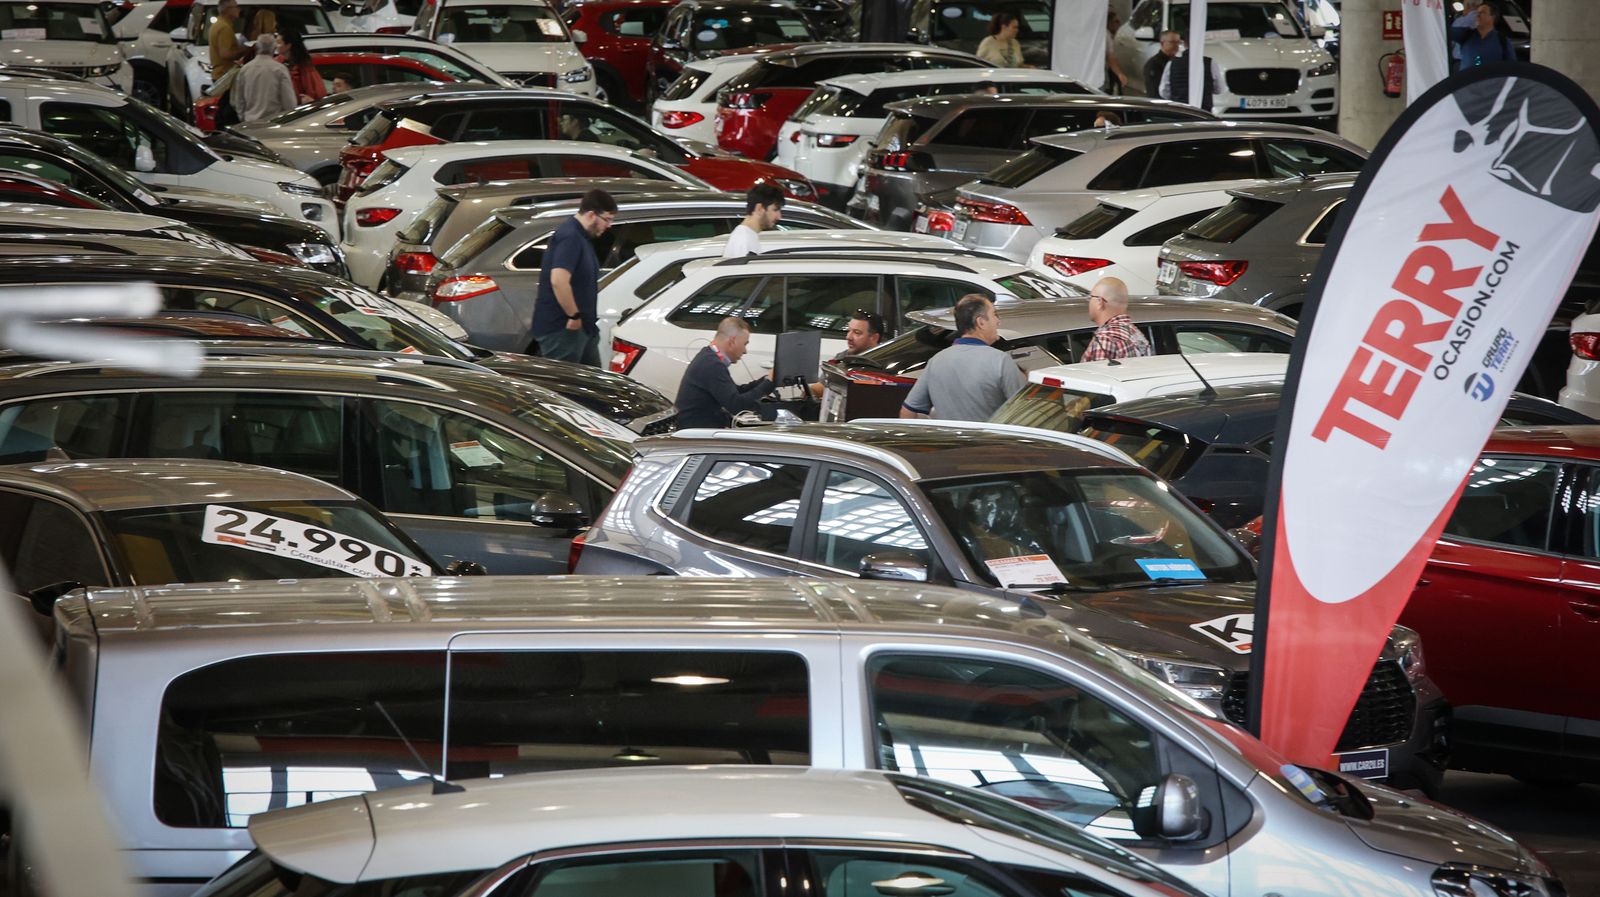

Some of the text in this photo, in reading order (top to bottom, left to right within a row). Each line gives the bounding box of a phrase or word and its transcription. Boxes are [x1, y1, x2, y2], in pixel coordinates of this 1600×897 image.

[1247, 98, 1268, 107] 4079
[1311, 184, 1501, 450] TERRY
[1433, 240, 1520, 381] OCASION.COM
[1482, 327, 1508, 368] GRUPO
[1490, 331, 1515, 370] TERRY
[290, 549, 350, 570] Consultar
